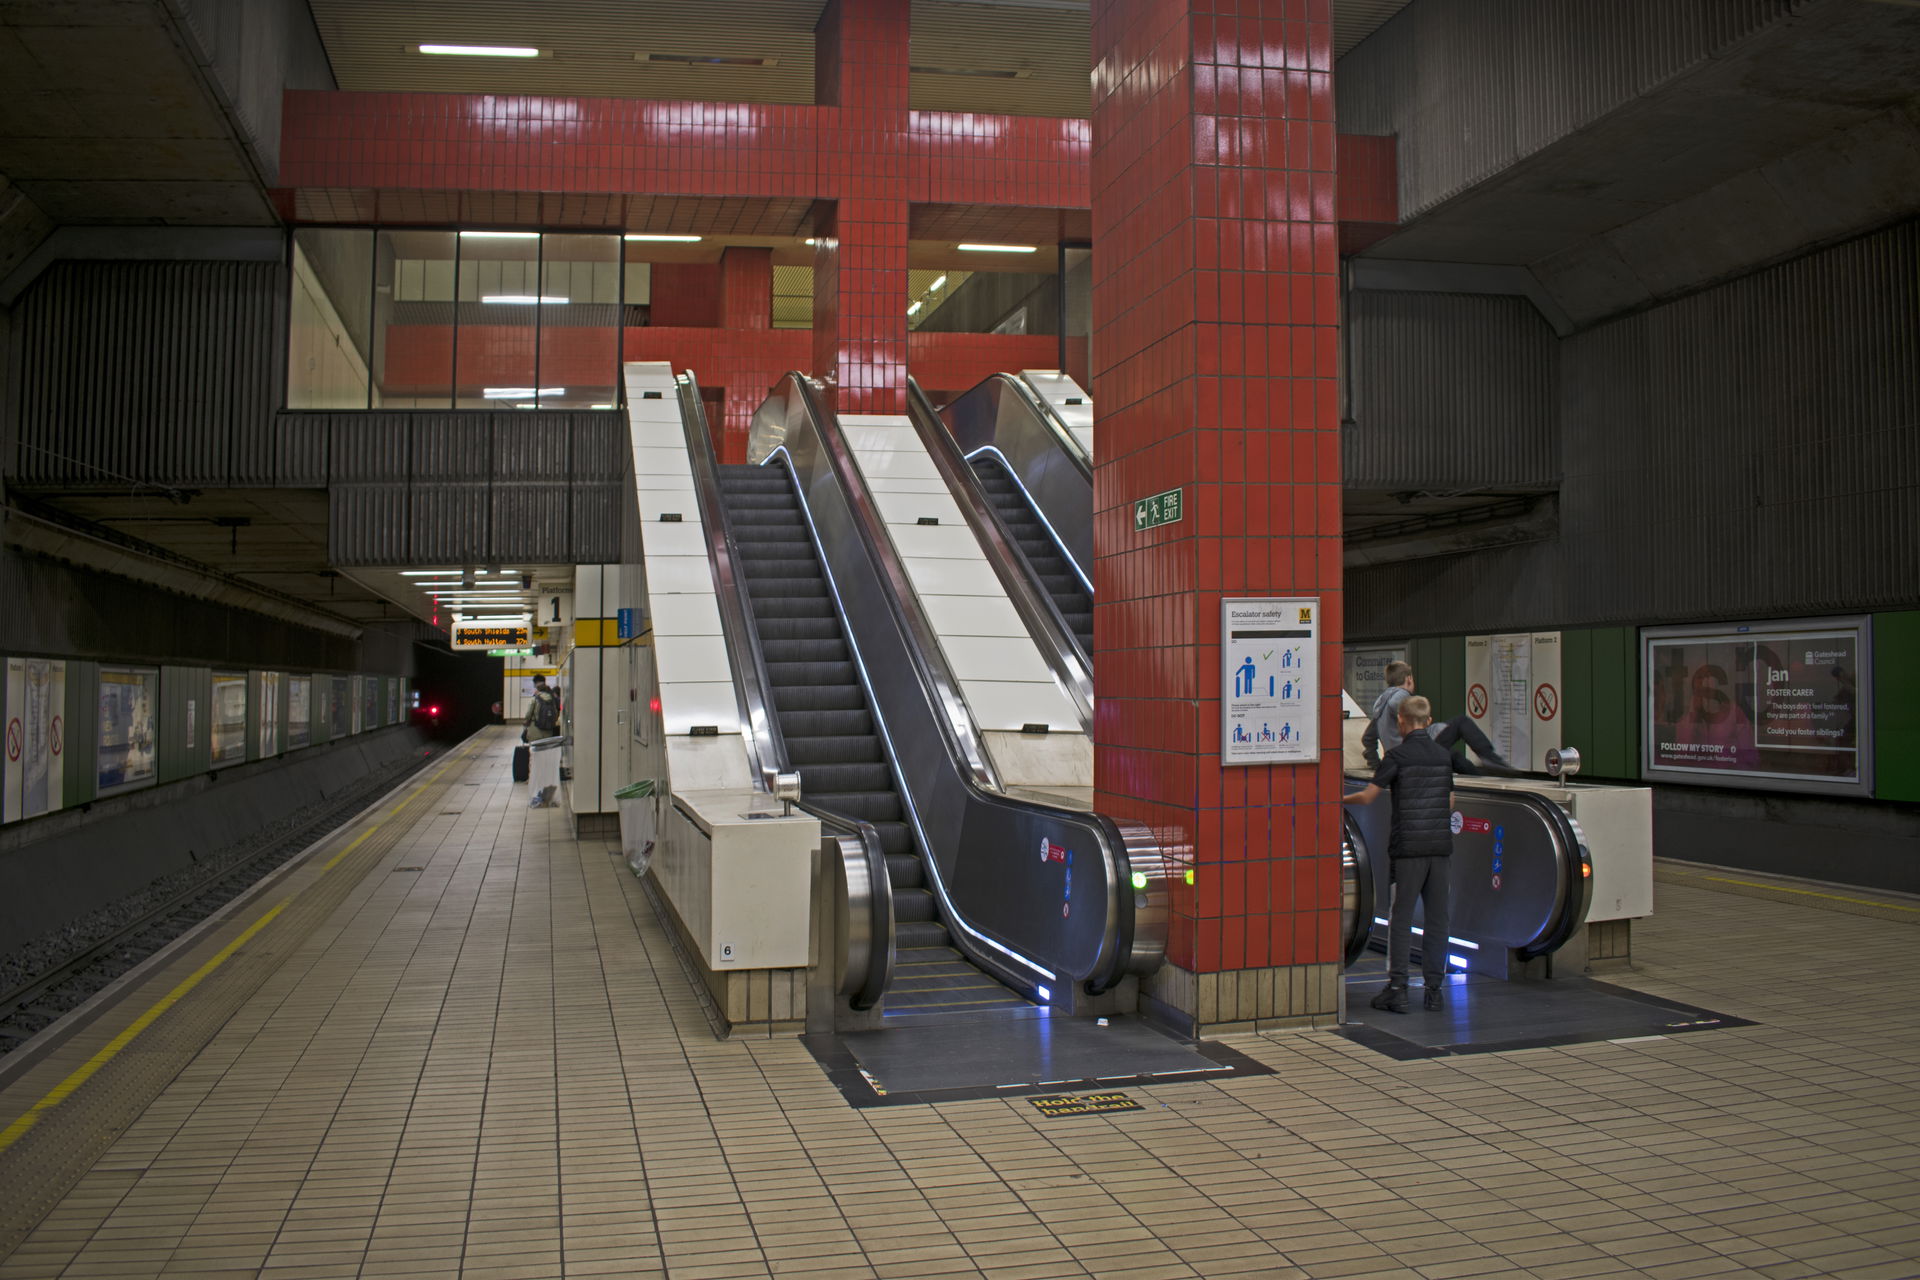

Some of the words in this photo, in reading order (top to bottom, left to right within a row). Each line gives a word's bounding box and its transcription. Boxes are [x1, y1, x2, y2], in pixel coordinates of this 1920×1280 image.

[1164, 494, 1178, 508] FIRE
[1164, 506, 1178, 520] EXIT
[551, 596, 561, 622] 1
[1262, 610, 1282, 618] safety
[1300, 609, 1310, 618] M
[1356, 672, 1363, 680] to
[1364, 671, 1385, 681] Gates
[1766, 666, 1789, 685] Jan
[1816, 729, 1844, 738] siblings?
[1660, 742, 1688, 751] FOLLOW
[1701, 744, 1724, 753] STORY
[724, 946, 731, 955] 6
[1032, 1097, 1084, 1107] Hold
[1042, 1100, 1135, 1115] handrail
